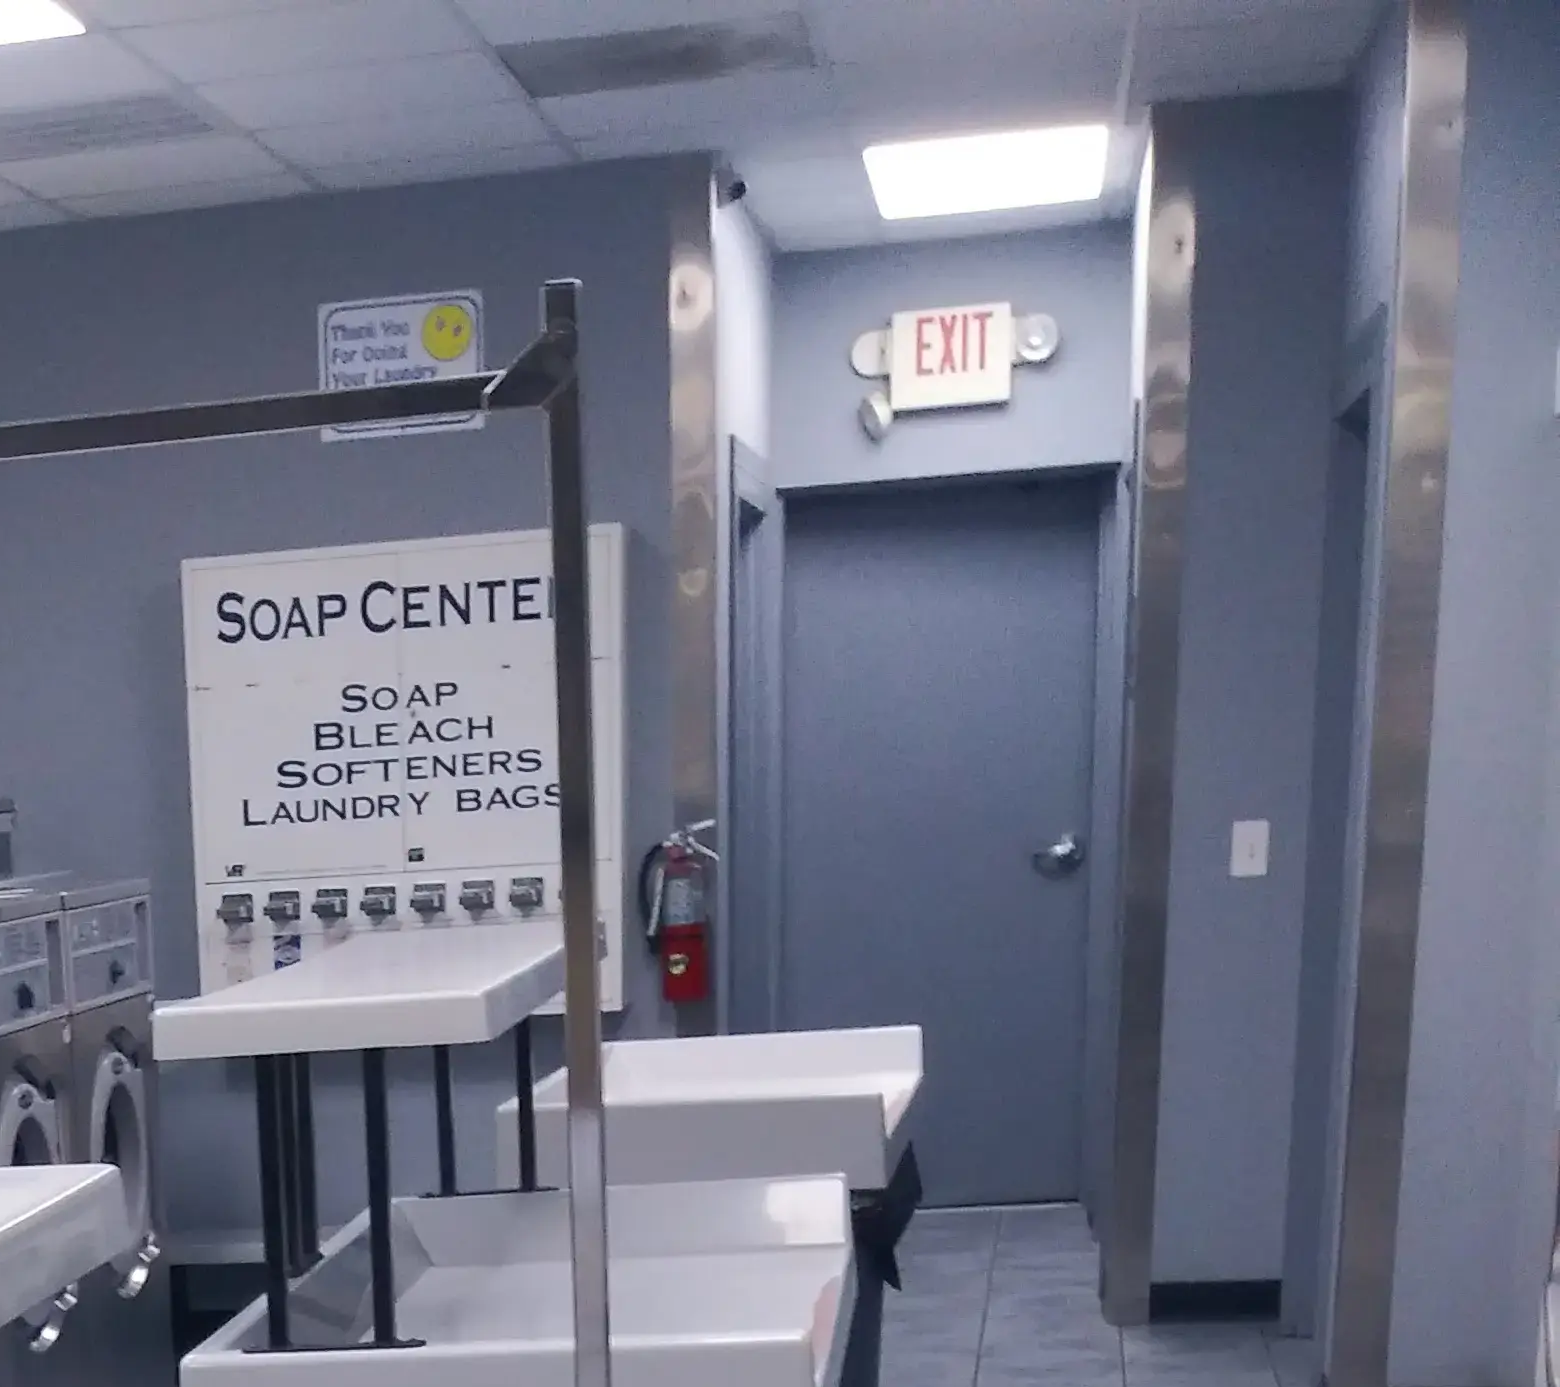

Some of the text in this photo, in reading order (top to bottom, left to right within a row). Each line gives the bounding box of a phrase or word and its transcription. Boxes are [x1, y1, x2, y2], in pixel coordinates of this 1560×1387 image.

[916, 311, 993, 376] EXIT
[216, 576, 556, 645] SOAP CENTE
[341, 682, 458, 713] SOAP
[314, 715, 494, 751] BLEACH
[277, 748, 543, 789] SOFTENERS
[243, 783, 561, 828] LAUNDRY BAGS
